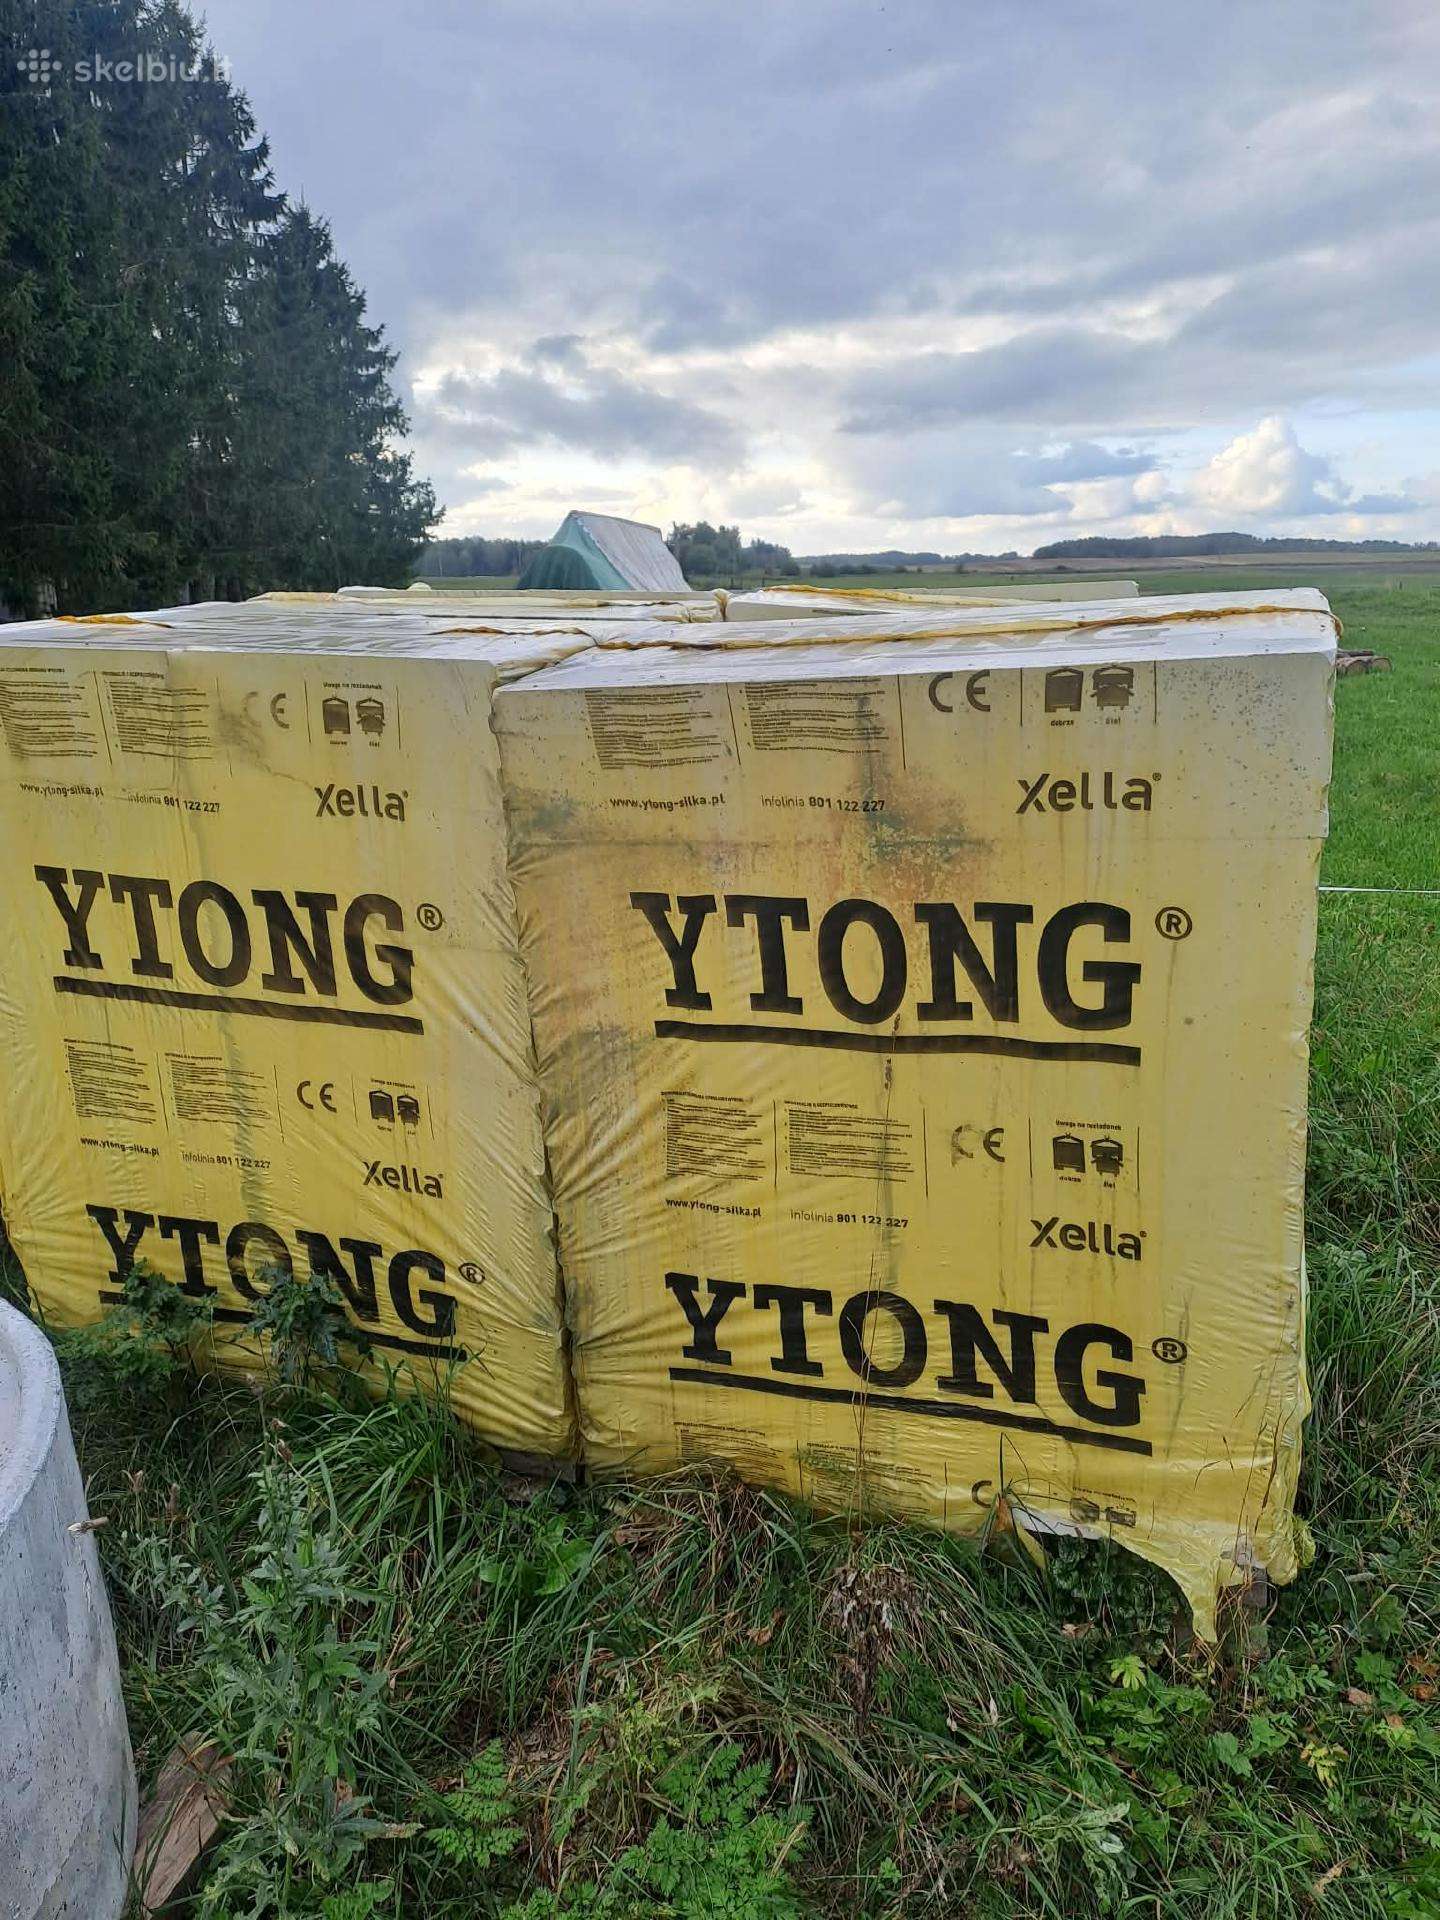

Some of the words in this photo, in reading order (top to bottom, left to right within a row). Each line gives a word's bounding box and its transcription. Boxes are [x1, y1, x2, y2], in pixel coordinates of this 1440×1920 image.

[184, 799, 201, 811] 122
[203, 801, 221, 813] 227
[314, 783, 405, 822] Xella
[609, 793, 727, 813] www.ytong-silka.pl
[760, 794, 805, 808] infolinia
[808, 796, 832, 810] 801
[836, 799, 859, 813] 122
[862, 799, 886, 813] 227
[1016, 771, 1152, 815] Xella
[34, 864, 416, 1006] YTONG
[629, 891, 1142, 1031] YTONG
[216, 1153, 233, 1166] 801
[235, 1155, 252, 1168] 122
[253, 1157, 271, 1169] 227
[362, 1160, 443, 1200] Xella
[665, 1197, 762, 1218] www.ytong-silka.pl
[790, 1208, 834, 1224] infolinia
[836, 1213, 857, 1224] 801
[861, 1214, 882, 1226] 122
[885, 1217, 909, 1229] 227
[1029, 1216, 1142, 1261] Xella
[85, 1203, 459, 1338] YTONG
[664, 1271, 1147, 1428] YTONG
